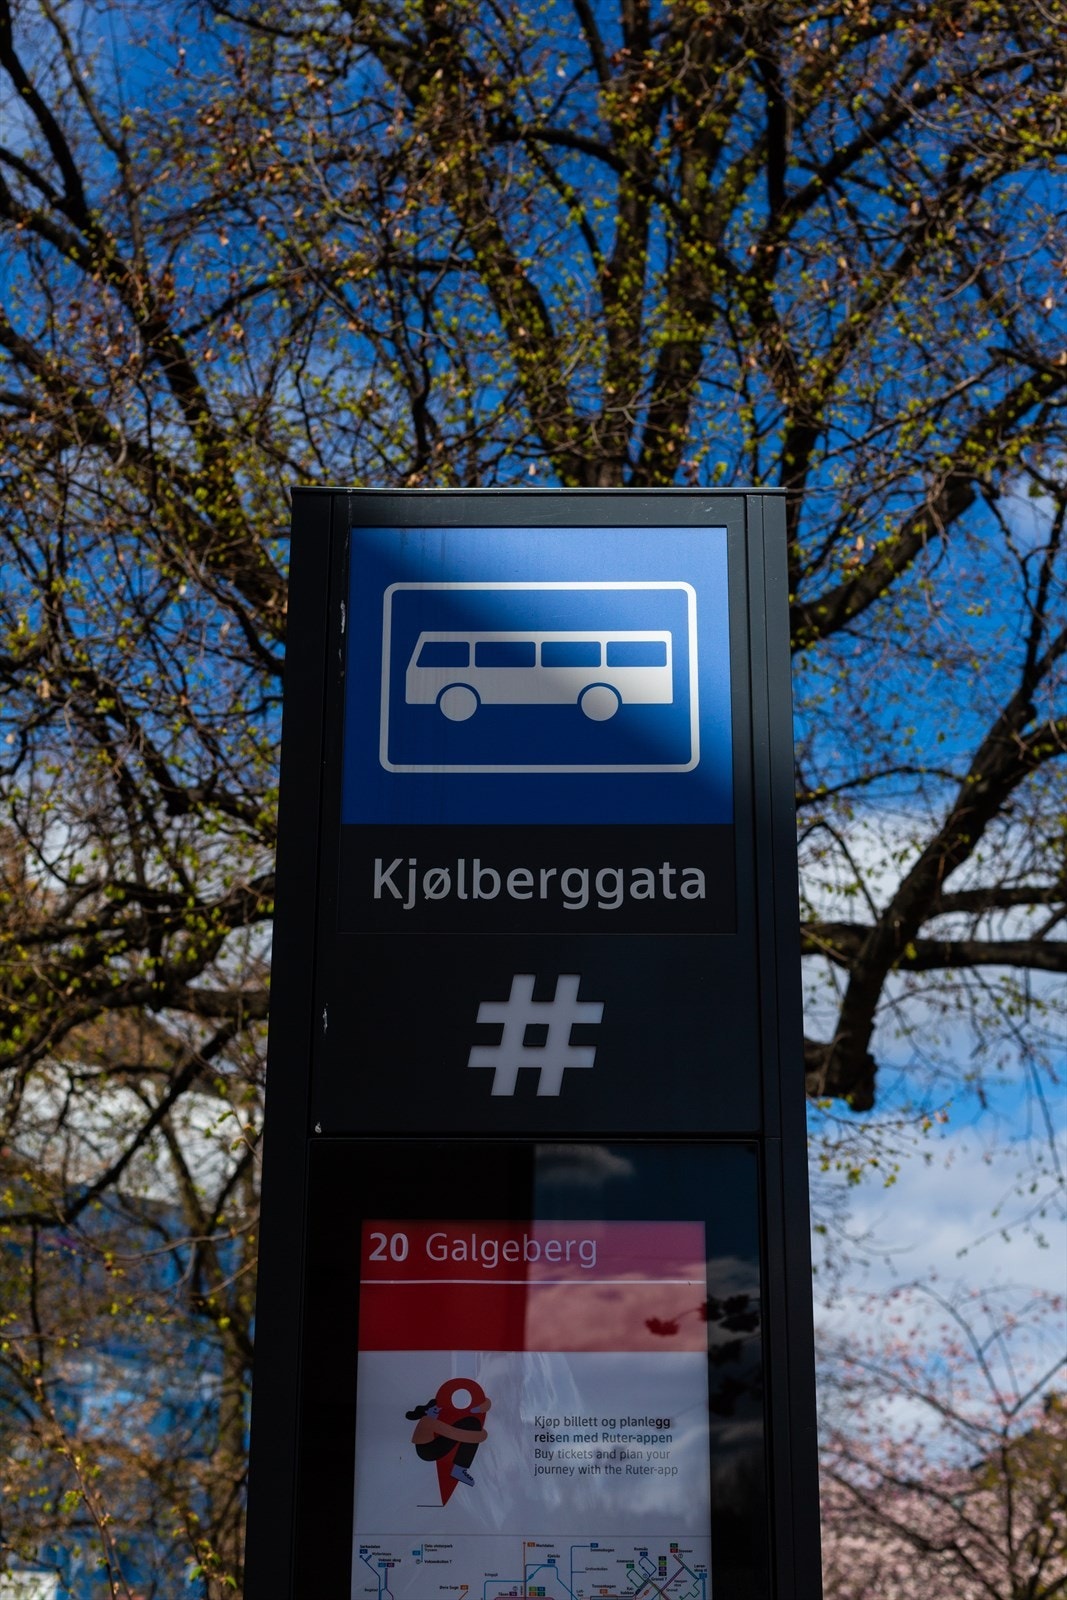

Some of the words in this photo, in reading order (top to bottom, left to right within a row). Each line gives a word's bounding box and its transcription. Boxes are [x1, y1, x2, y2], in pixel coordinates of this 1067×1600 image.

[373, 858, 706, 910] Kjølberggata
[368, 1232, 410, 1262] 20
[425, 1232, 597, 1269] Galgeberg
[534, 1416, 560, 1428] Kjøp
[564, 1416, 598, 1427] billett
[601, 1418, 616, 1429] og
[619, 1416, 671, 1429] planlegg
[534, 1432, 570, 1443] reisen
[573, 1432, 598, 1443] med
[602, 1432, 673, 1445] Ruter-appen
[534, 1448, 555, 1461] Buy
[557, 1449, 593, 1459] tickets
[596, 1449, 616, 1459] and
[619, 1449, 643, 1461] plan
[646, 1451, 671, 1462] your
[533, 1464, 575, 1476] journey
[578, 1464, 599, 1475] with
[604, 1464, 622, 1475] the
[625, 1464, 678, 1477] Ruter-app
